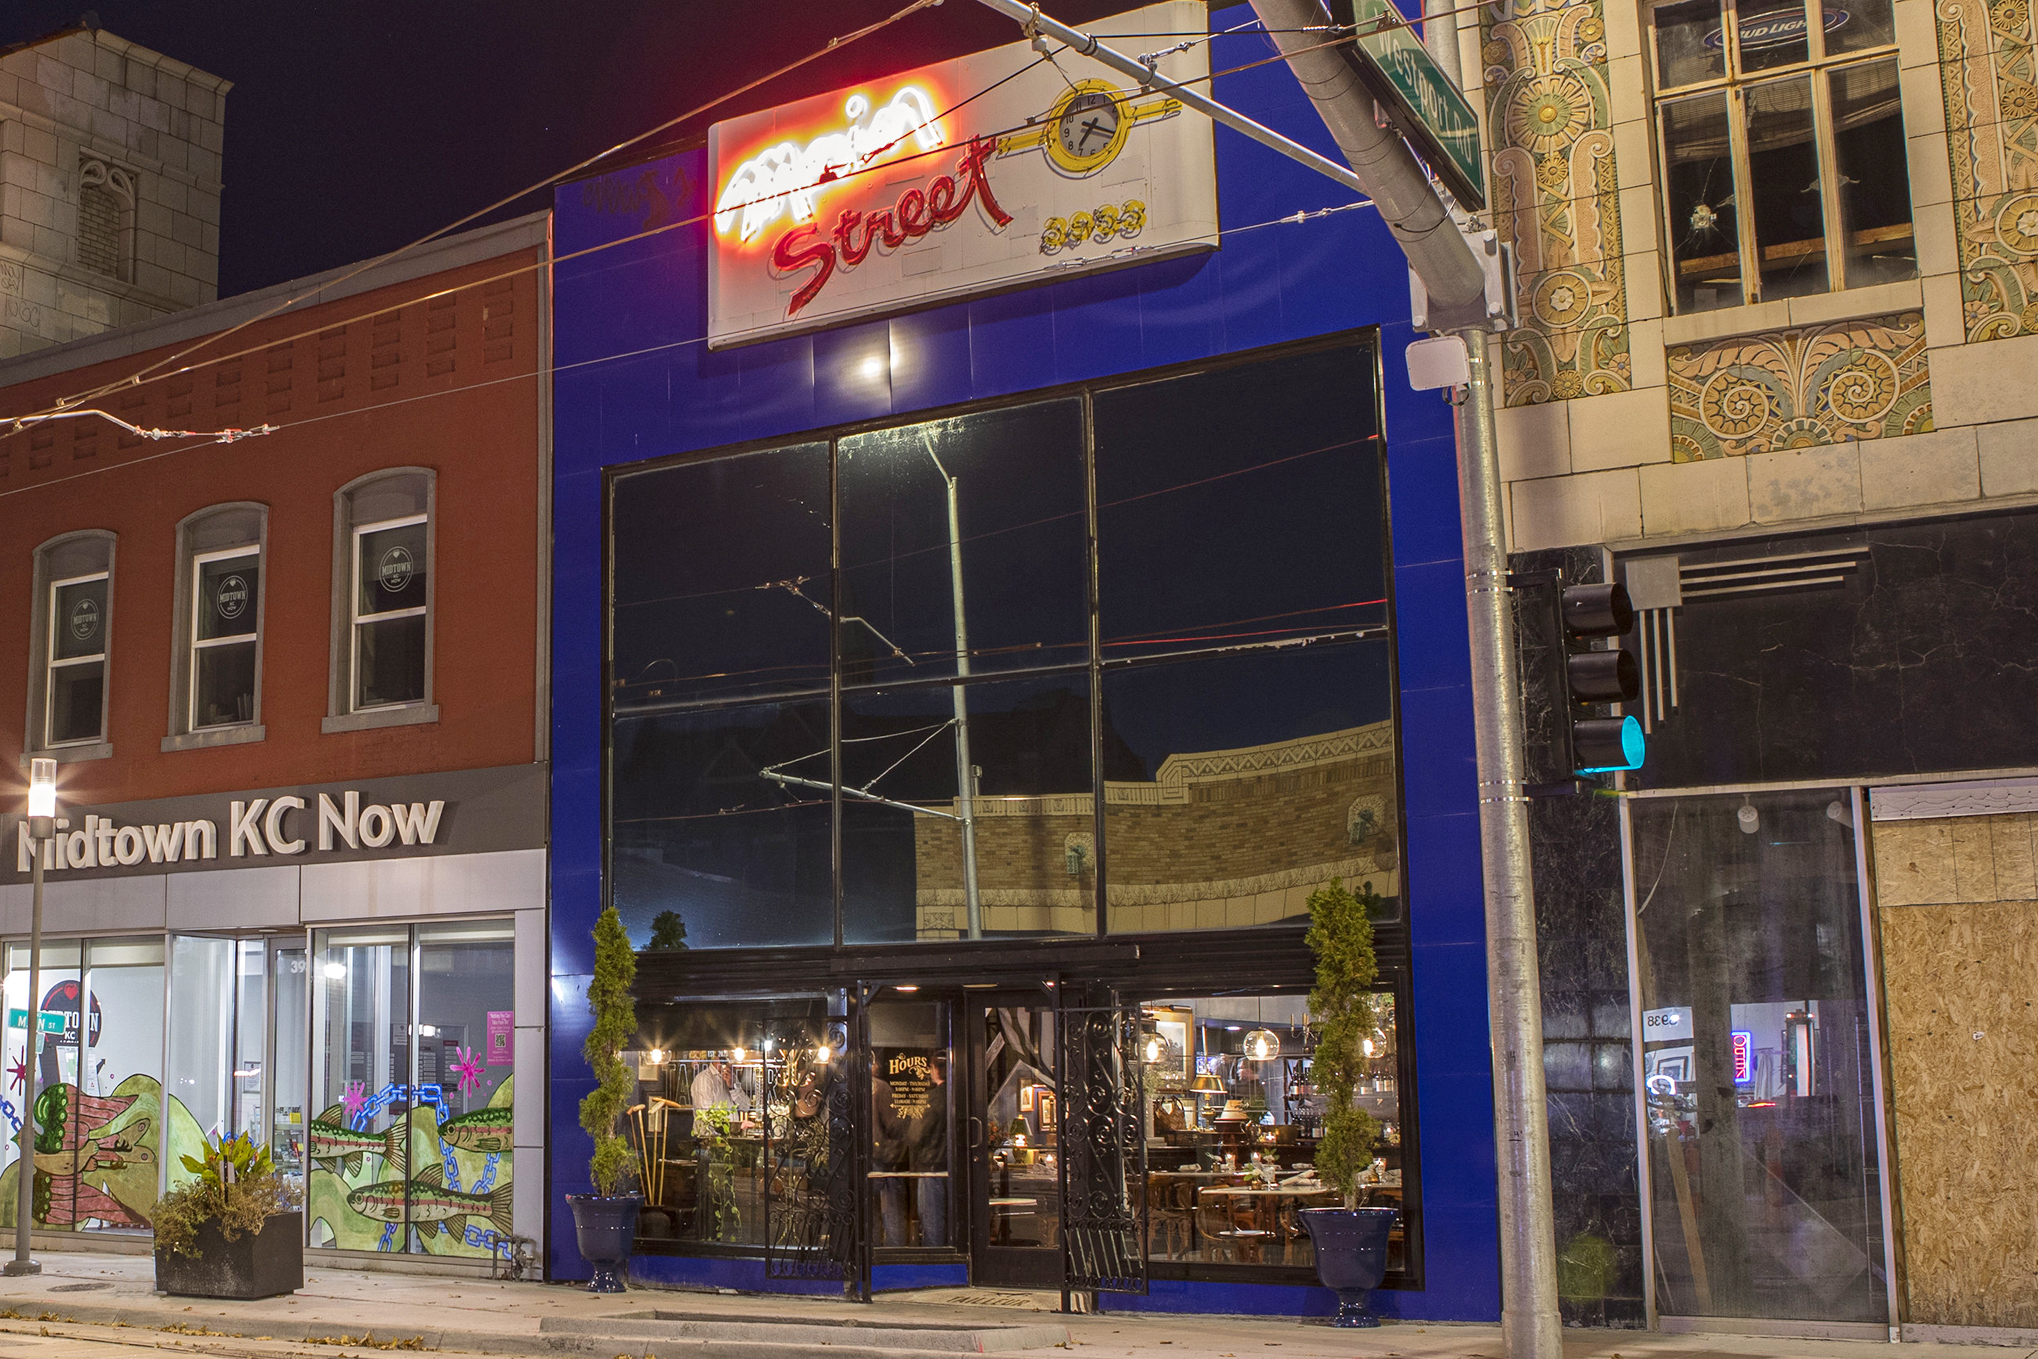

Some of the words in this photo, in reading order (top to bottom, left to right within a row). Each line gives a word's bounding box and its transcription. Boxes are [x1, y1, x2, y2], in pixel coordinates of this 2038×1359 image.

[1769, 19, 1807, 34] LIGH
[1374, 7, 1450, 138] Westport
[1453, 110, 1473, 167] Rd
[771, 133, 1014, 316] Street
[381, 561, 411, 577] MIDTOWN
[219, 590, 246, 604] MIDTOWN
[73, 613, 97, 625] MIDTOWN
[18, 813, 217, 872] Midtown
[230, 795, 306, 857] KC
[319, 790, 445, 850] Now
[18, 1015, 45, 1030] MN
[889, 1056, 928, 1075] HOURS
